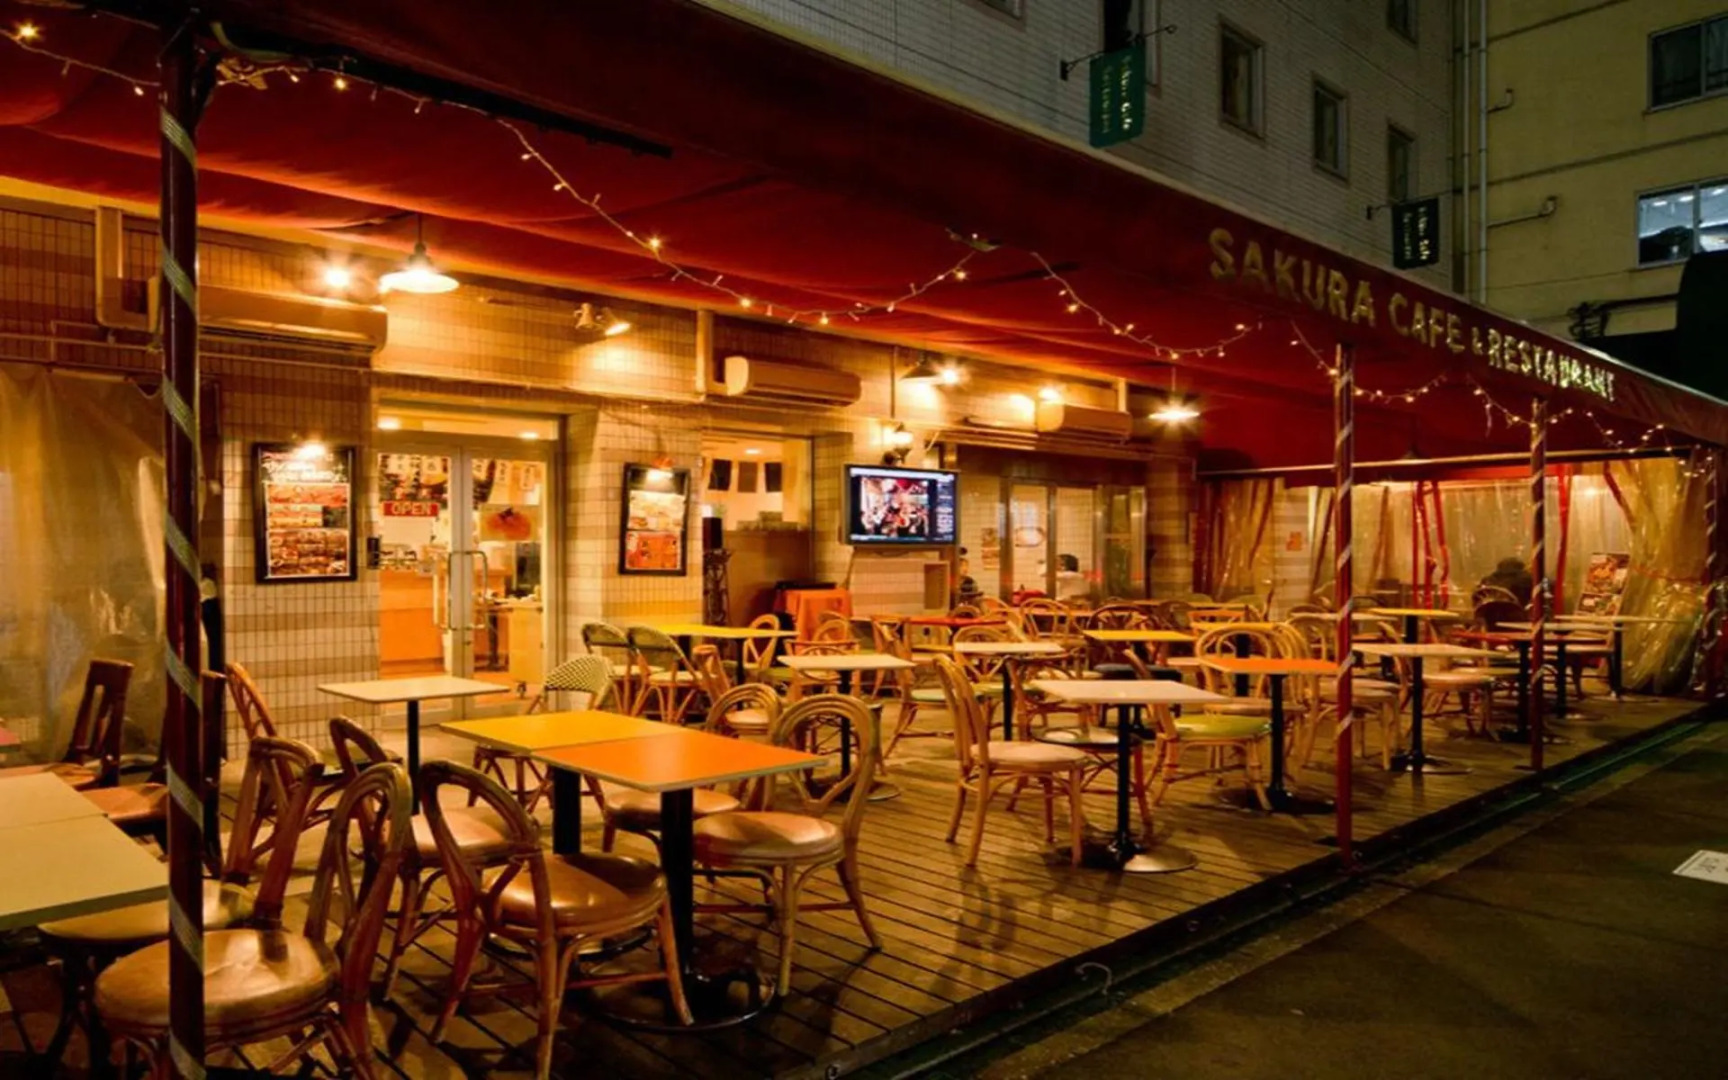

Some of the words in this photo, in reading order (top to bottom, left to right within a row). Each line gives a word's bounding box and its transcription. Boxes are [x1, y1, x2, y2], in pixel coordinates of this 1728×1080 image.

[1209, 228, 1376, 327] SAKURA
[1388, 292, 1465, 352] CAFE
[1488, 328, 1615, 401] RESTAURANT
[391, 502, 432, 515] OPEN
